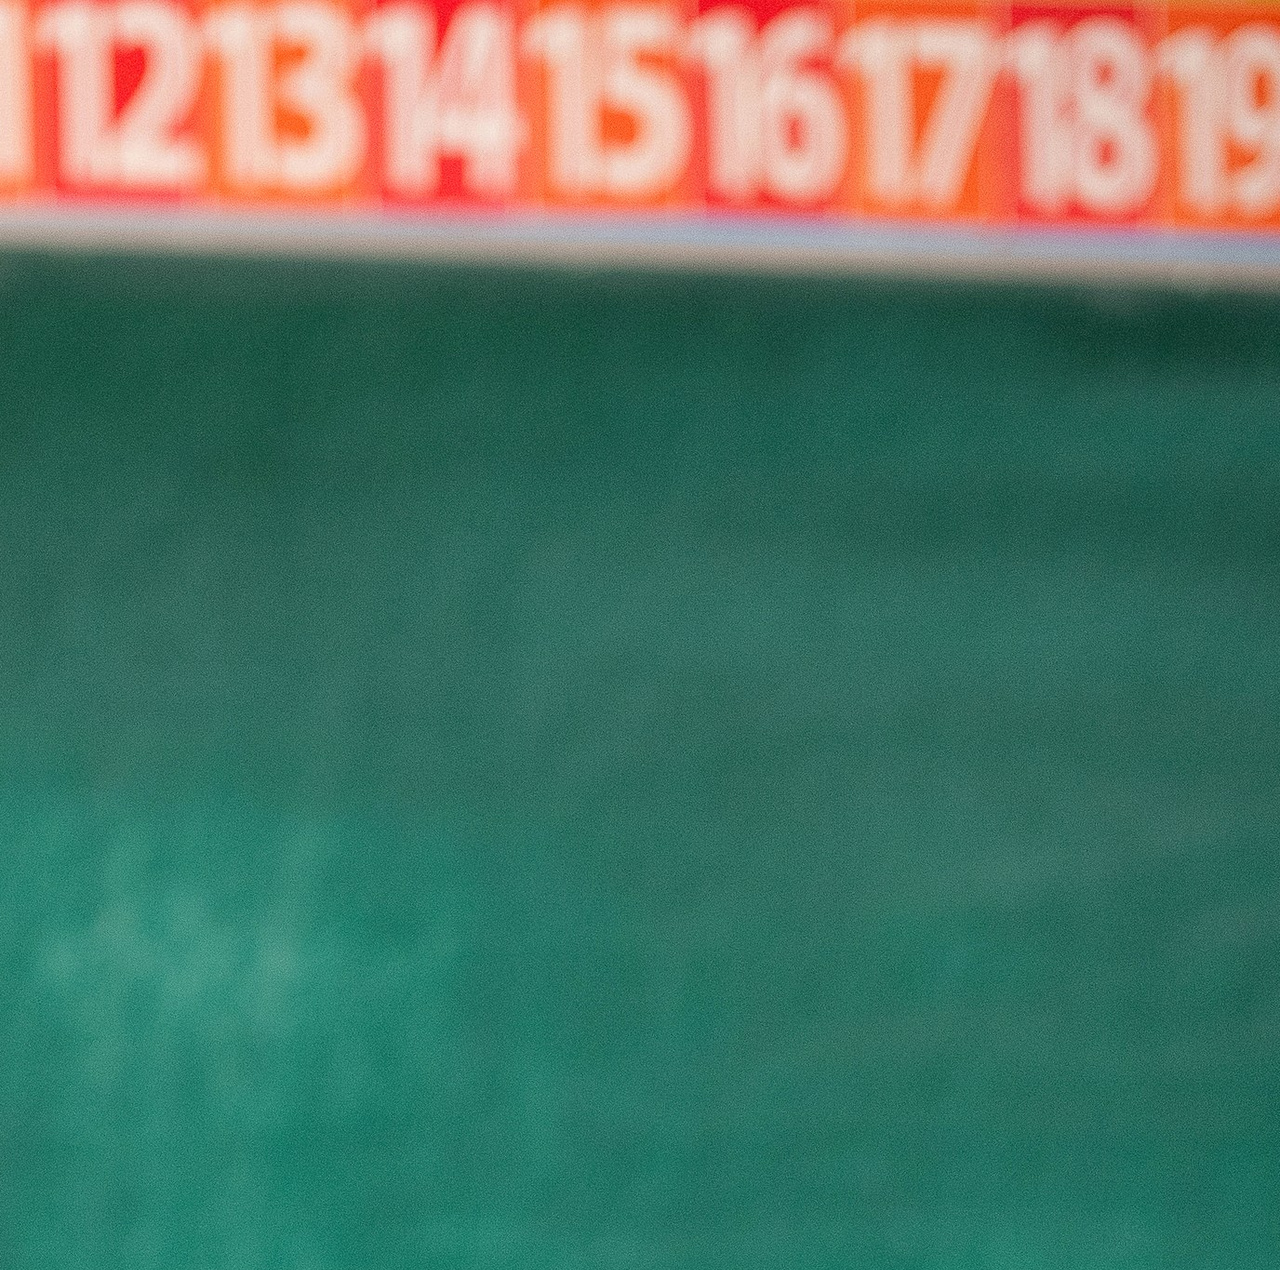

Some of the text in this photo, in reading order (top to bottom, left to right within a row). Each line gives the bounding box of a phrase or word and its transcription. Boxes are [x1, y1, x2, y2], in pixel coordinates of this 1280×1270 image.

[33, 2, 209, 184] 12
[202, 4, 371, 188] 13
[364, 5, 528, 195] 14
[524, 6, 693, 199] 15
[689, 8, 850, 201] 16
[834, 18, 1006, 212] 17
[1002, 16, 1157, 214] 18
[1154, 22, 1280, 218] 19
